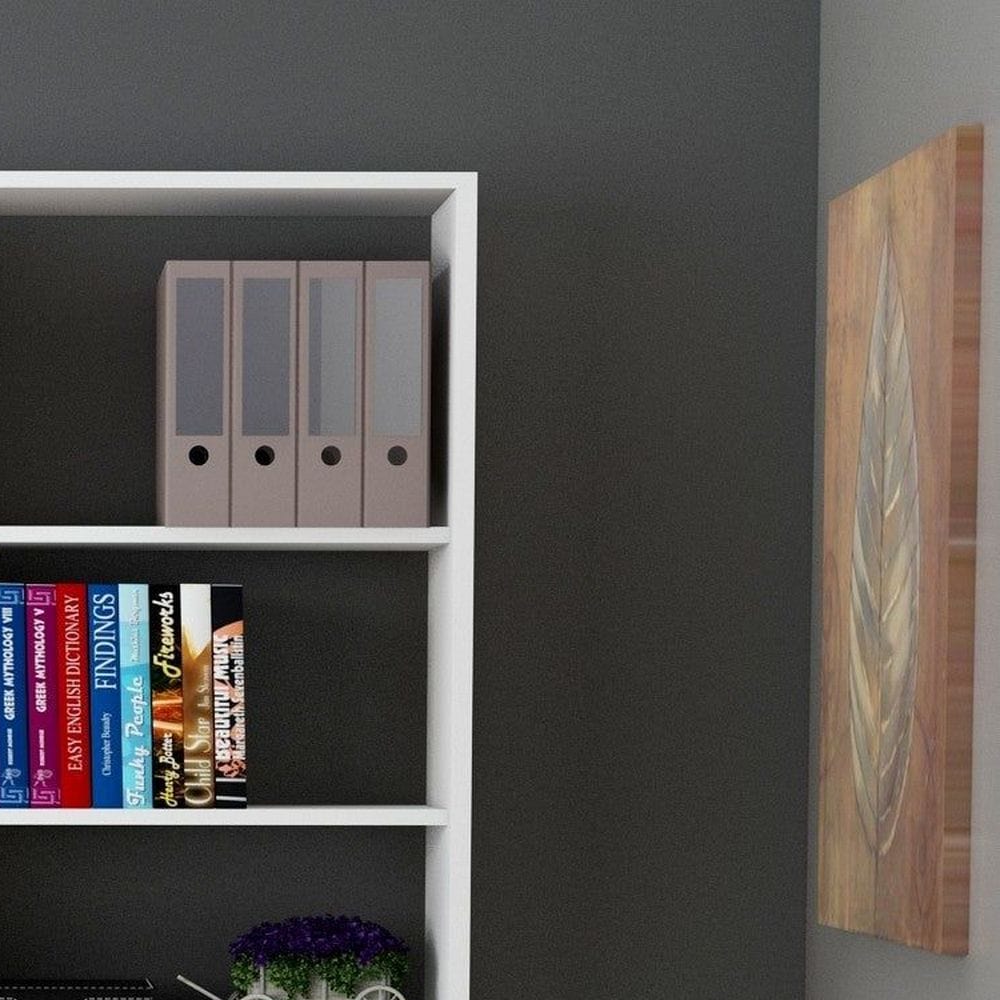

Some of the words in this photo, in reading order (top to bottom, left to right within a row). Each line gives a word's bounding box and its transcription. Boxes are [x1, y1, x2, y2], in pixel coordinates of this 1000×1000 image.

[2, 608, 13, 624] VIII
[33, 608, 44, 616] V
[64, 594, 80, 676] DICTIONARY
[152, 592, 181, 678] Fireworks
[2, 626, 14, 687] MYTHOLOGY
[34, 619, 46, 679] MYTHOLOGY
[93, 594, 117, 689] FINDINGS
[4, 689, 15, 720] GREEK
[35, 682, 47, 712] GREEK
[66, 679, 82, 733] ENGLISH
[125, 676, 147, 737] People
[68, 737, 82, 771] EASY
[184, 717, 212, 753] Star
[126, 745, 150, 805] Funky
[184, 760, 212, 804] Child
